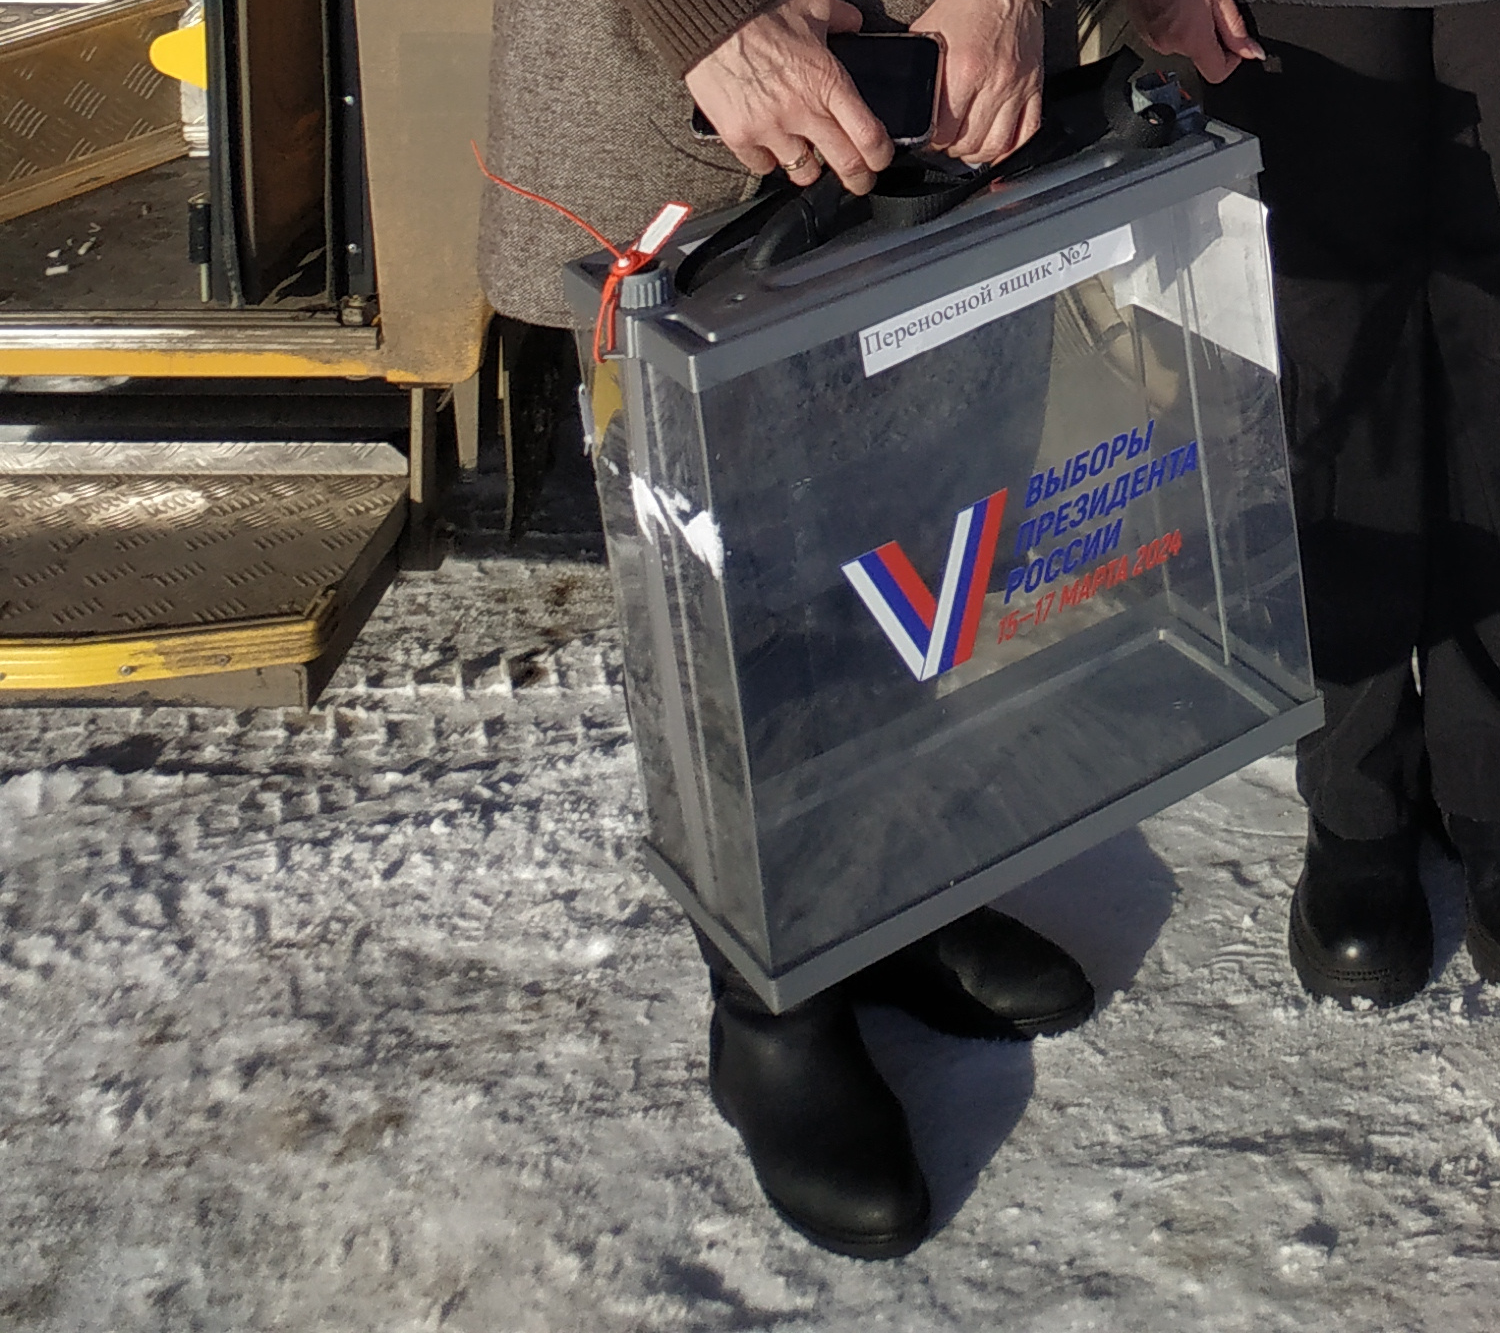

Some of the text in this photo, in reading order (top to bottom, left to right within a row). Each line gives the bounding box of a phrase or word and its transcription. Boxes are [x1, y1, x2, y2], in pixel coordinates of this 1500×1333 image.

[863, 284, 993, 356] Переносной
[998, 262, 1053, 299] ящик
[1014, 439, 1198, 558] ПРЕЗИДЕНТА
[1025, 419, 1155, 510] ВЫБОРЫ
[1004, 518, 1124, 605] РОССИИ
[1058, 555, 1129, 613] МАРТА
[1132, 529, 1183, 577] 2024
